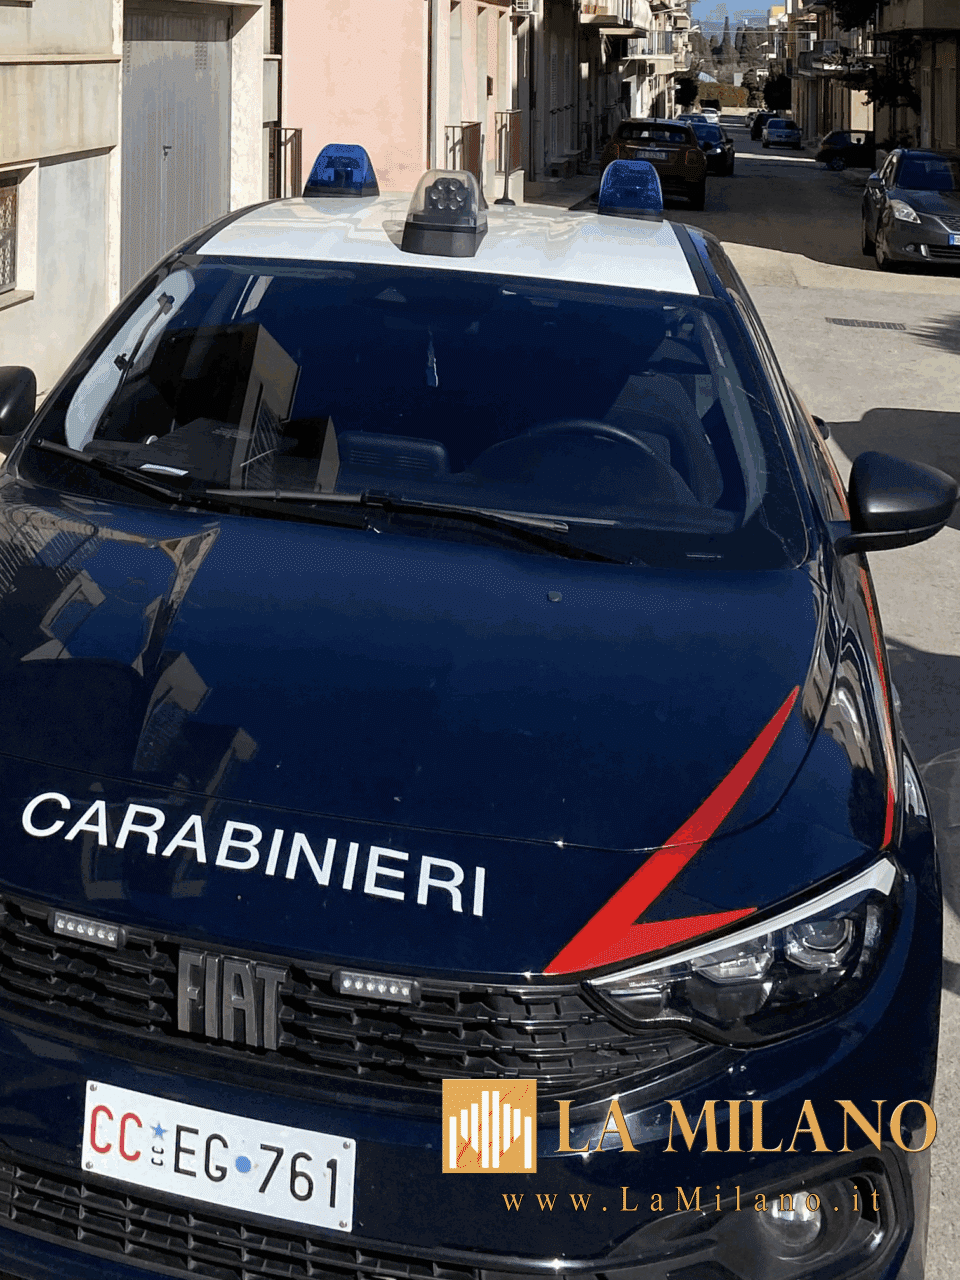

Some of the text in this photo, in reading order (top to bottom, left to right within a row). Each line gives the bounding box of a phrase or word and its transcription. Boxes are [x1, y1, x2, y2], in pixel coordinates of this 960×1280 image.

[21, 791, 486, 917] CARABINIERI
[177, 950, 289, 1051] FIAT
[89, 1104, 338, 1209] CC EG 761
